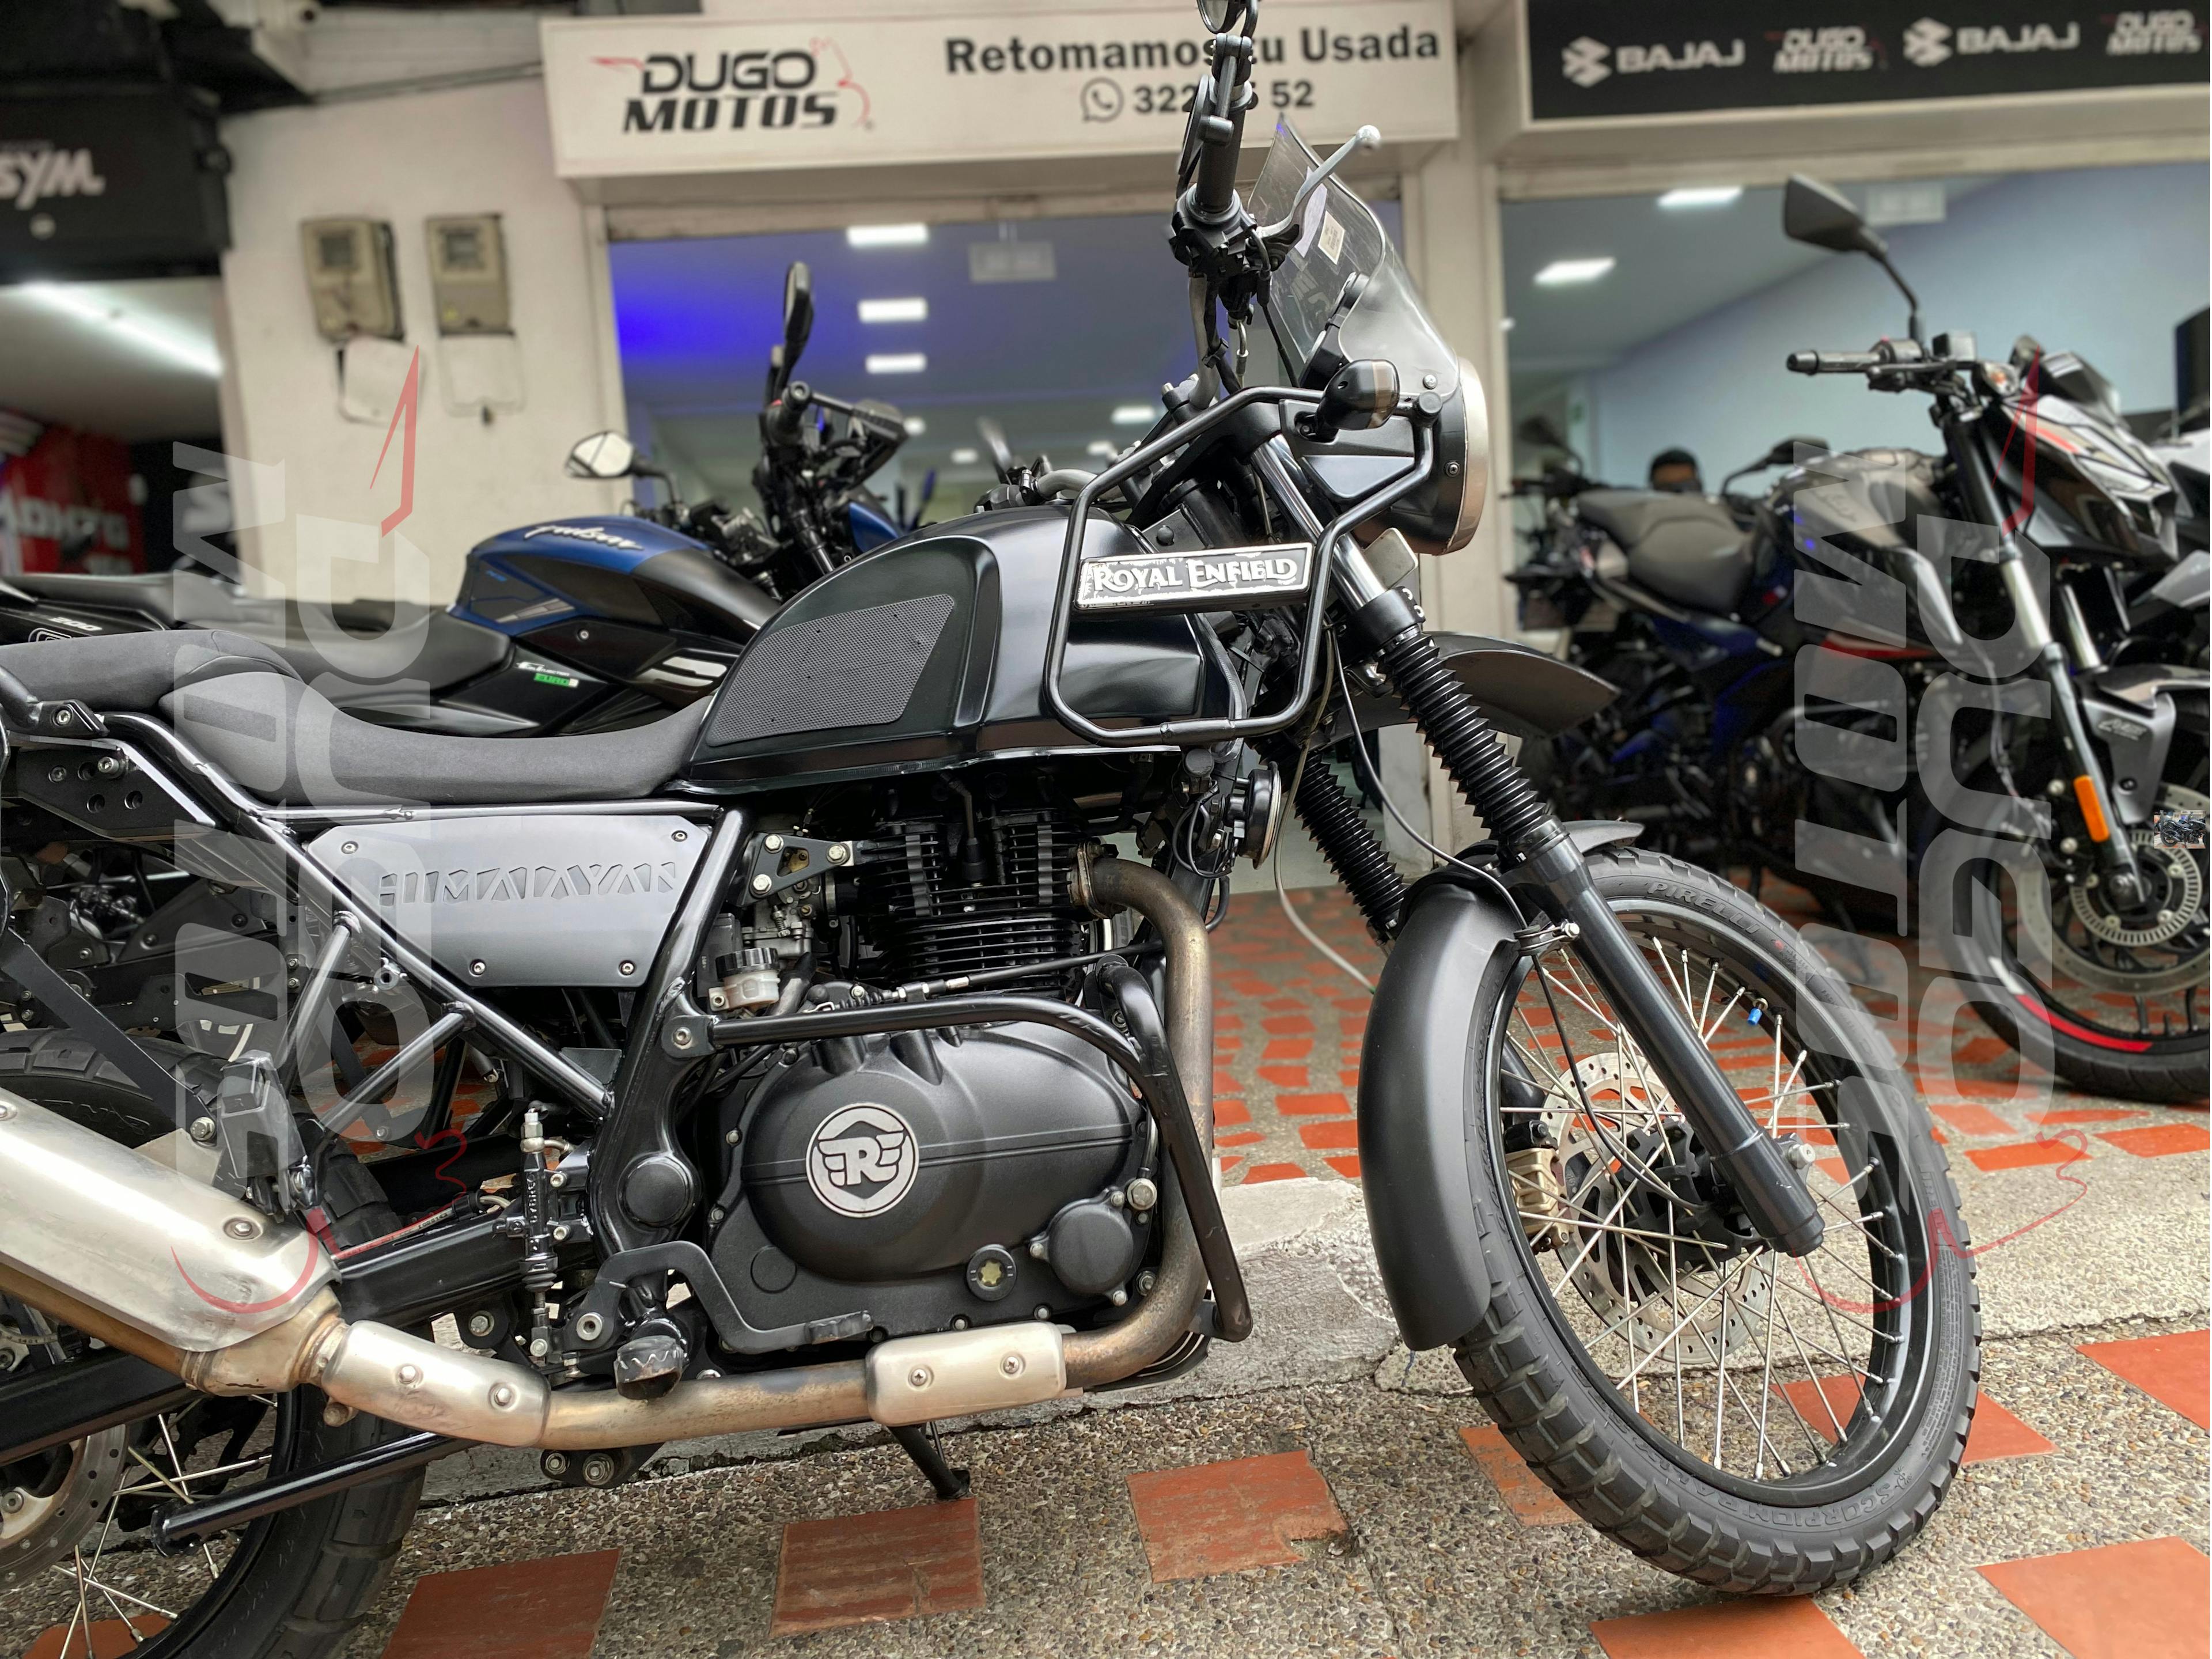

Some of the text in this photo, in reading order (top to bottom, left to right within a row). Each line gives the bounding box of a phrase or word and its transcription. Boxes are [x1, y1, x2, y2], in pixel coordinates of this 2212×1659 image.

[1301, 24, 1438, 61] Usada
[1616, 40, 1744, 74] BAJAJ
[1957, 22, 2080, 55] BAJAJ
[641, 50, 817, 93] DUGO
[623, 92, 838, 132] MOTOS
[1093, 558, 1298, 593] ROYAL ENFIELD
[378, 861, 676, 907] HIMALAYAN
[1647, 880, 1760, 934] PIRELLI
[1747, 1482, 1895, 1528] SCORPION
